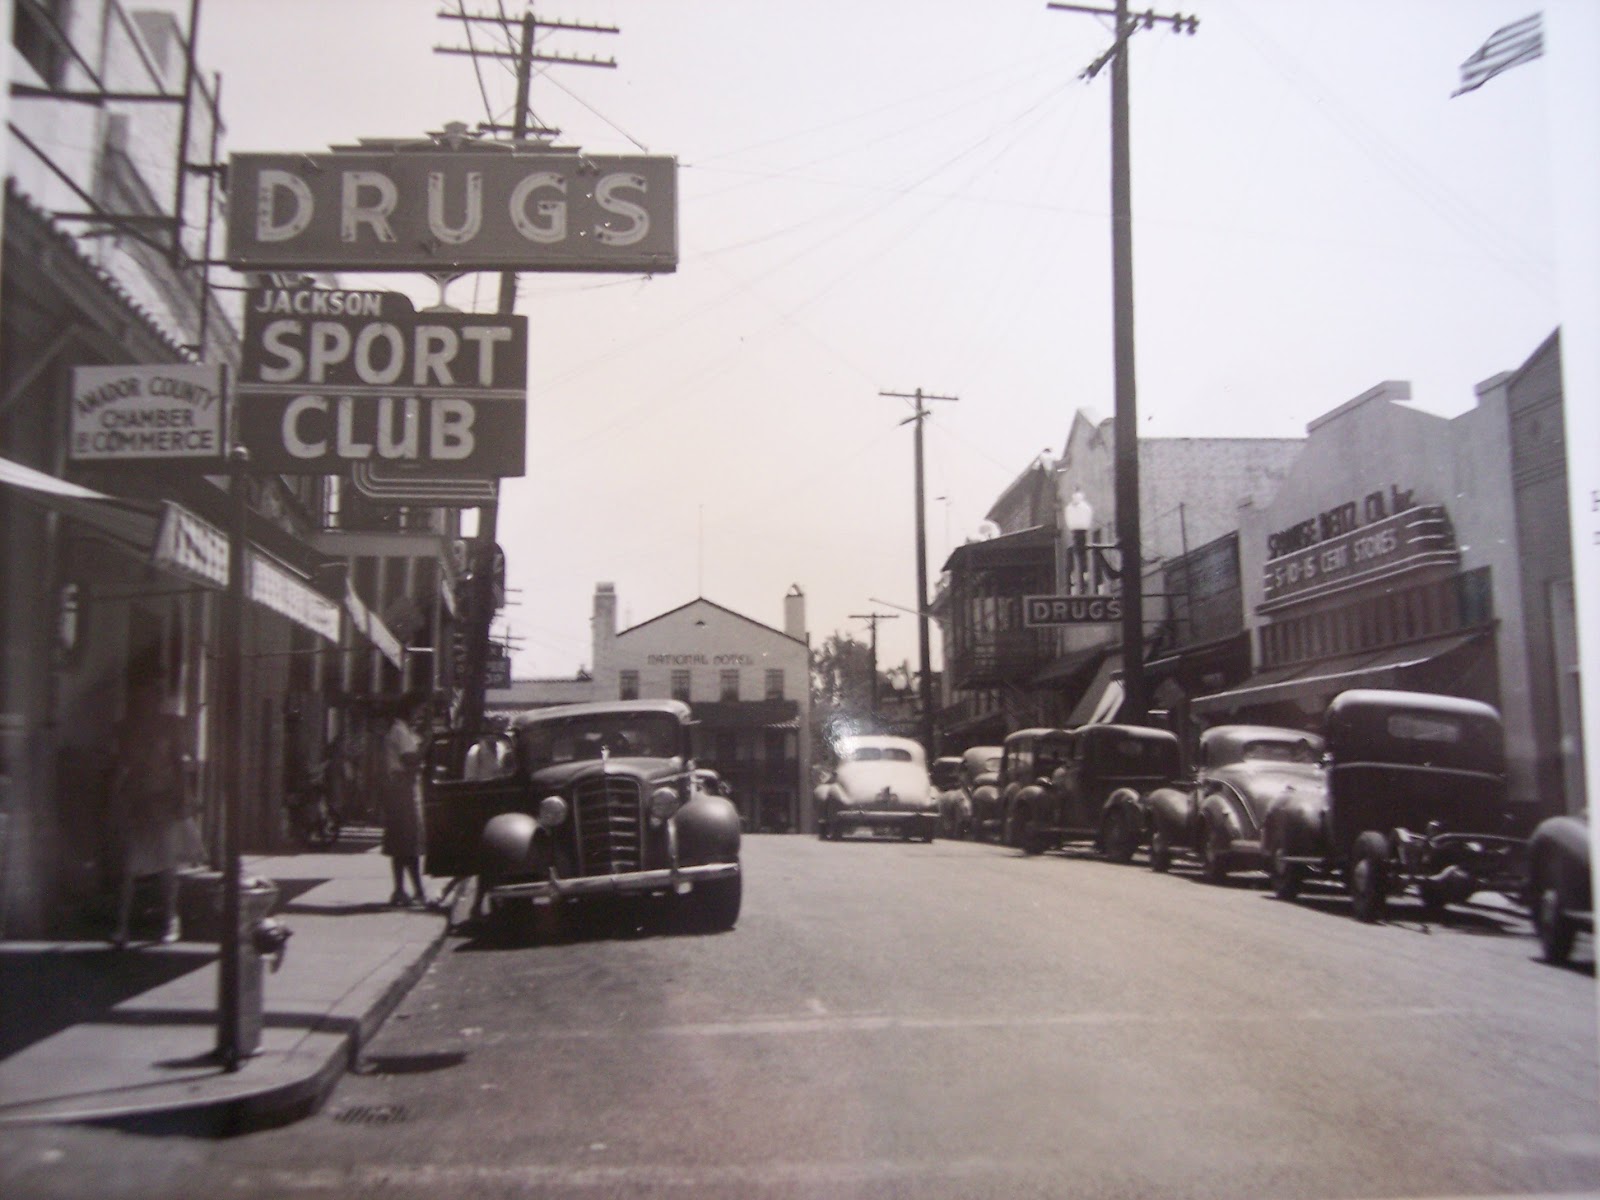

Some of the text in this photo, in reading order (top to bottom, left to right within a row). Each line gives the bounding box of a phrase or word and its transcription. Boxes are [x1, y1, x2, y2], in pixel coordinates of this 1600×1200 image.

[256, 168, 651, 247] DRUGS
[255, 290, 382, 317] JACKSON
[259, 319, 513, 386] SPORT
[101, 408, 194, 429] CHAMBER
[282, 395, 476, 460] CLUB
[94, 430, 213, 452] COMMERCE
[1032, 601, 1122, 619] DRUGS
[647, 654, 754, 666] NATIONAL HOTEL
